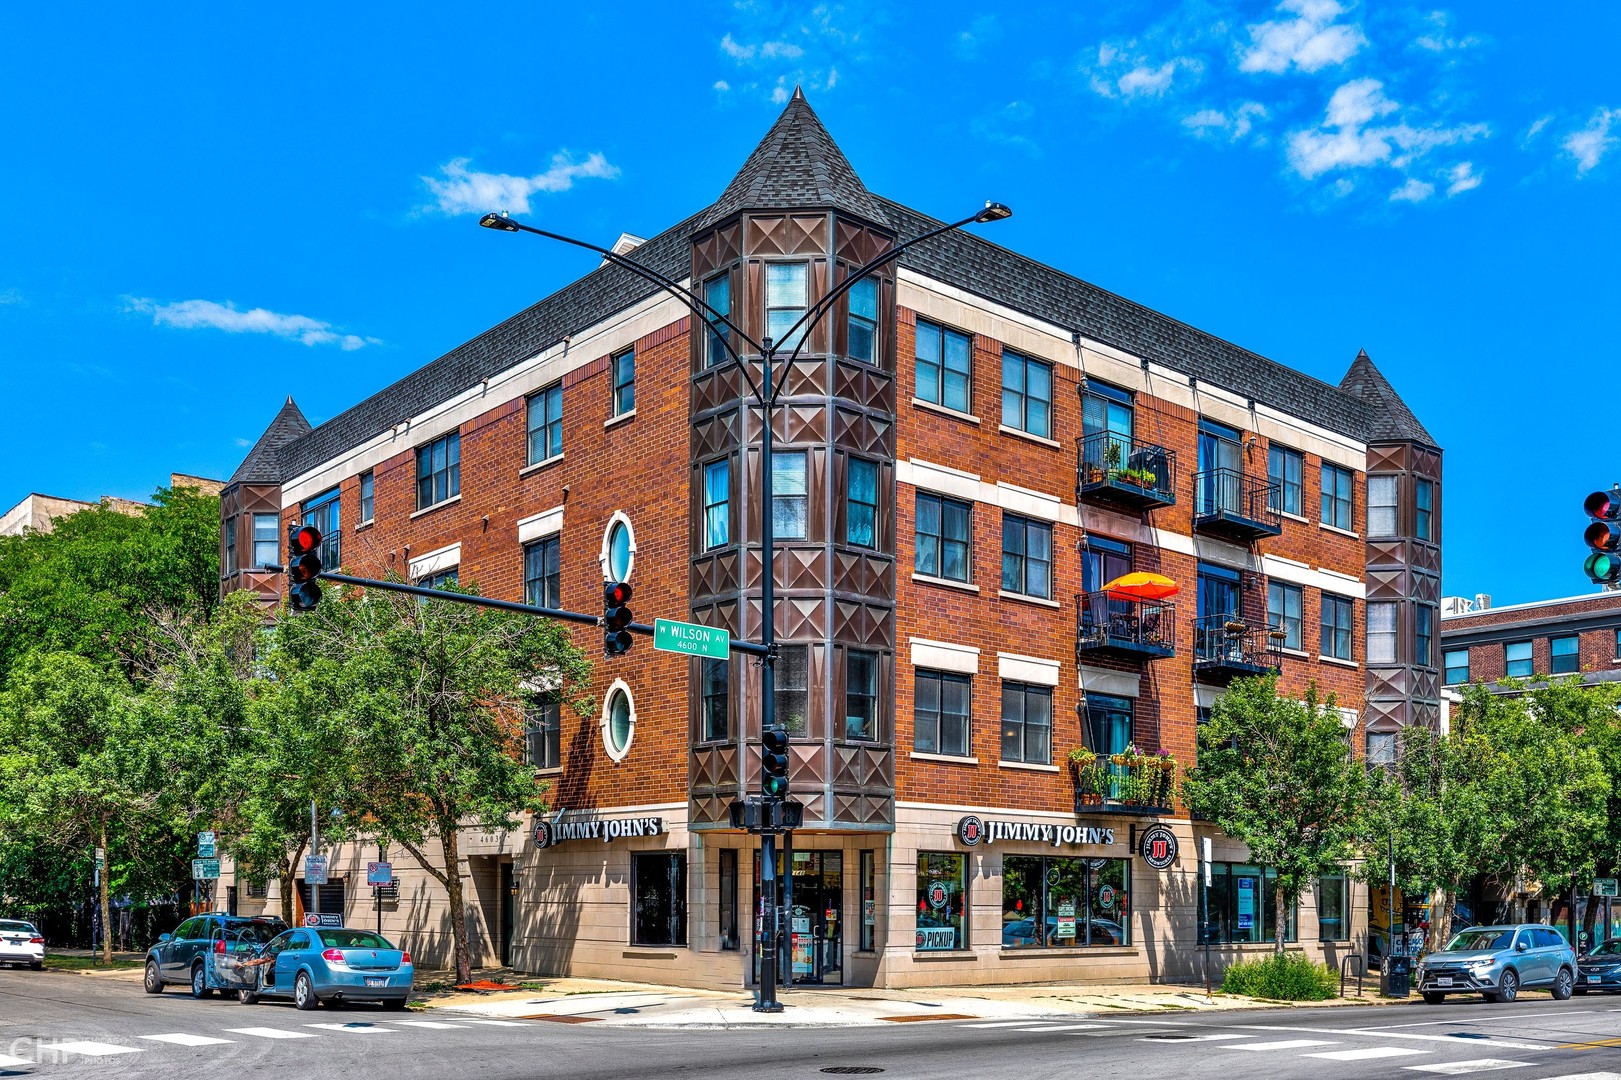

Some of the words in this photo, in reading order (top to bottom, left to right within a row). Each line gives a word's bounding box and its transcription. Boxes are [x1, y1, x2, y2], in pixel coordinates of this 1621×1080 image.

[660, 625, 666, 634] W
[671, 625, 710, 642] WILSON
[715, 635, 725, 643] AV
[677, 640, 697, 651] 4600
[702, 644, 708, 652] N
[551, 821, 599, 846] JIMMY
[603, 818, 657, 843] JOHN'S
[987, 821, 1051, 844] JIMMY
[1055, 825, 1115, 847] JOHN'S
[1153, 841, 1167, 858] JJ
[926, 931, 954, 948] PICKUP
